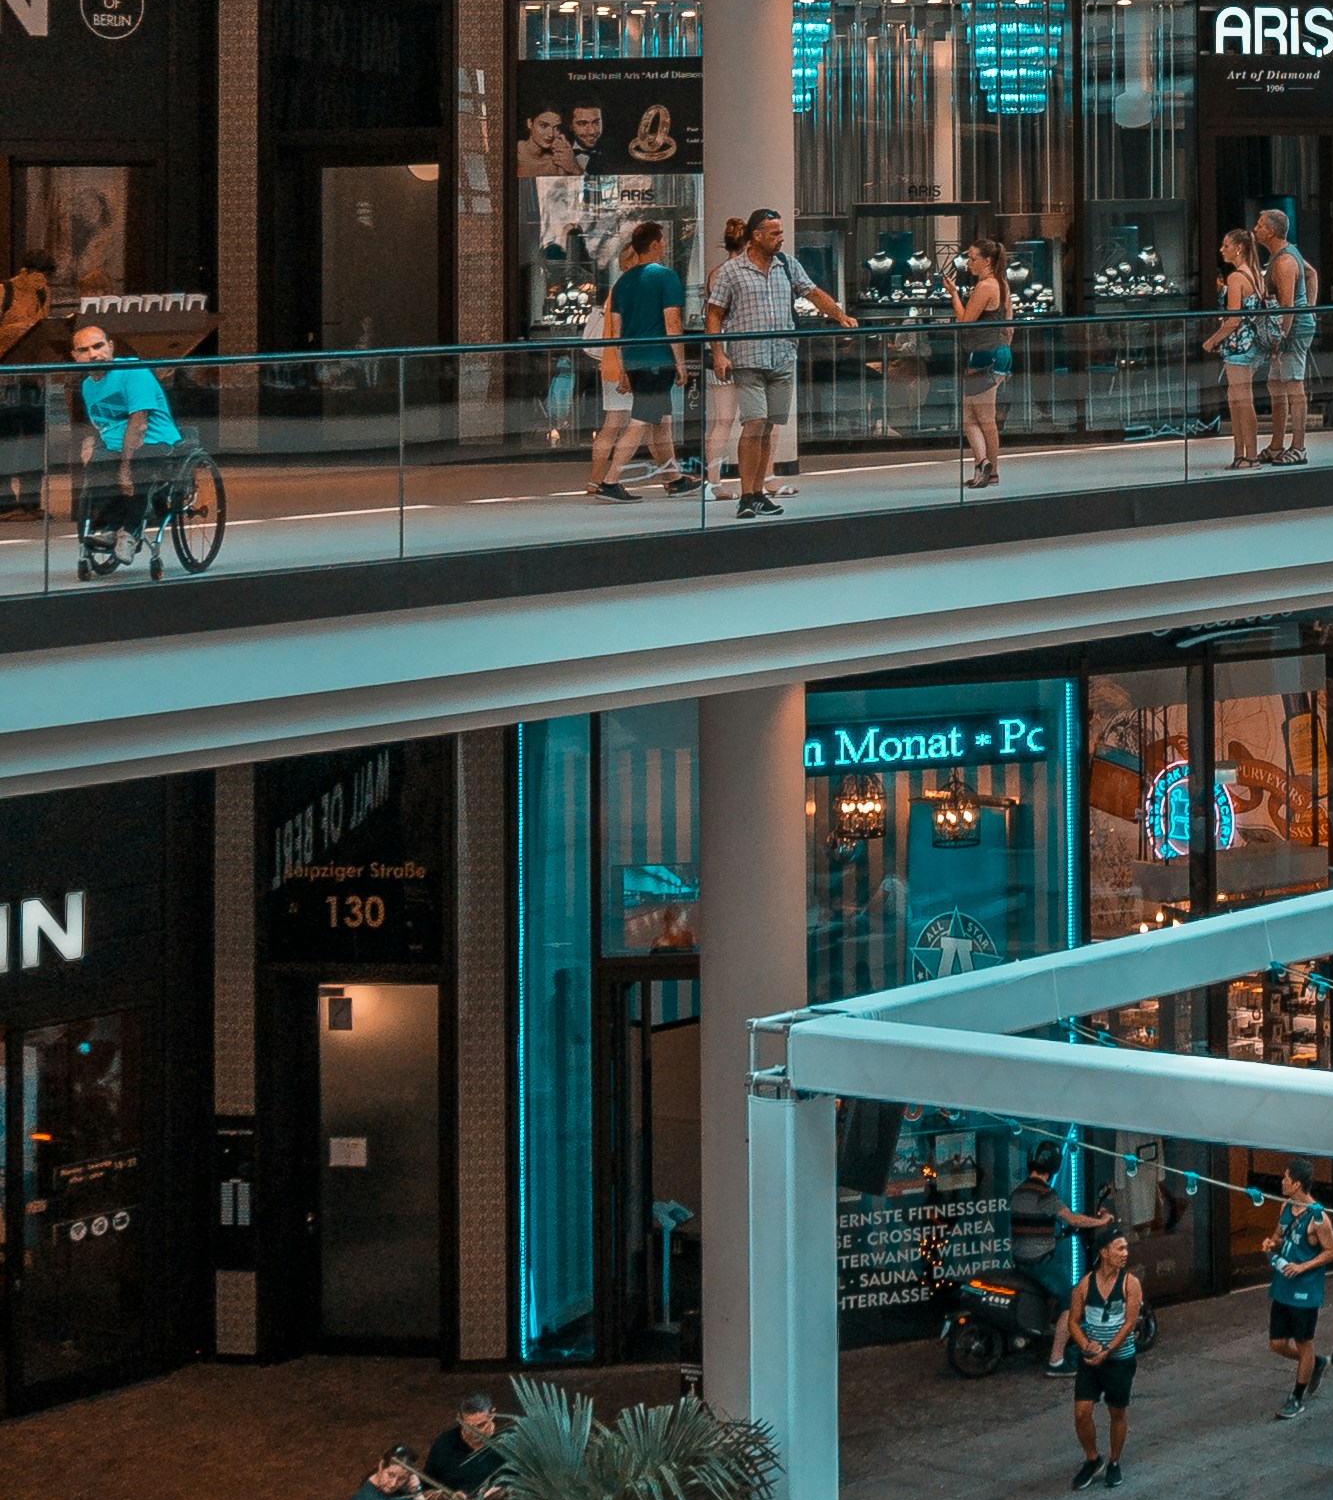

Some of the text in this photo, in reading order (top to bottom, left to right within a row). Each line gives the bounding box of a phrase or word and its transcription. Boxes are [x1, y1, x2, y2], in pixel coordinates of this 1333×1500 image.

[93, 13, 132, 27] BERLIN
[671, 70, 704, 79] Diamon
[1227, 69, 1321, 82] Art of Diamond
[1266, 84, 1285, 93] 1906
[834, 725, 965, 767] Monat
[325, 895, 386, 929] 130
[926, 920, 990, 950] ALL STAR
[867, 1220, 996, 1247] CROSSFIT-AREA
[859, 1269, 919, 1288] SAUNA
